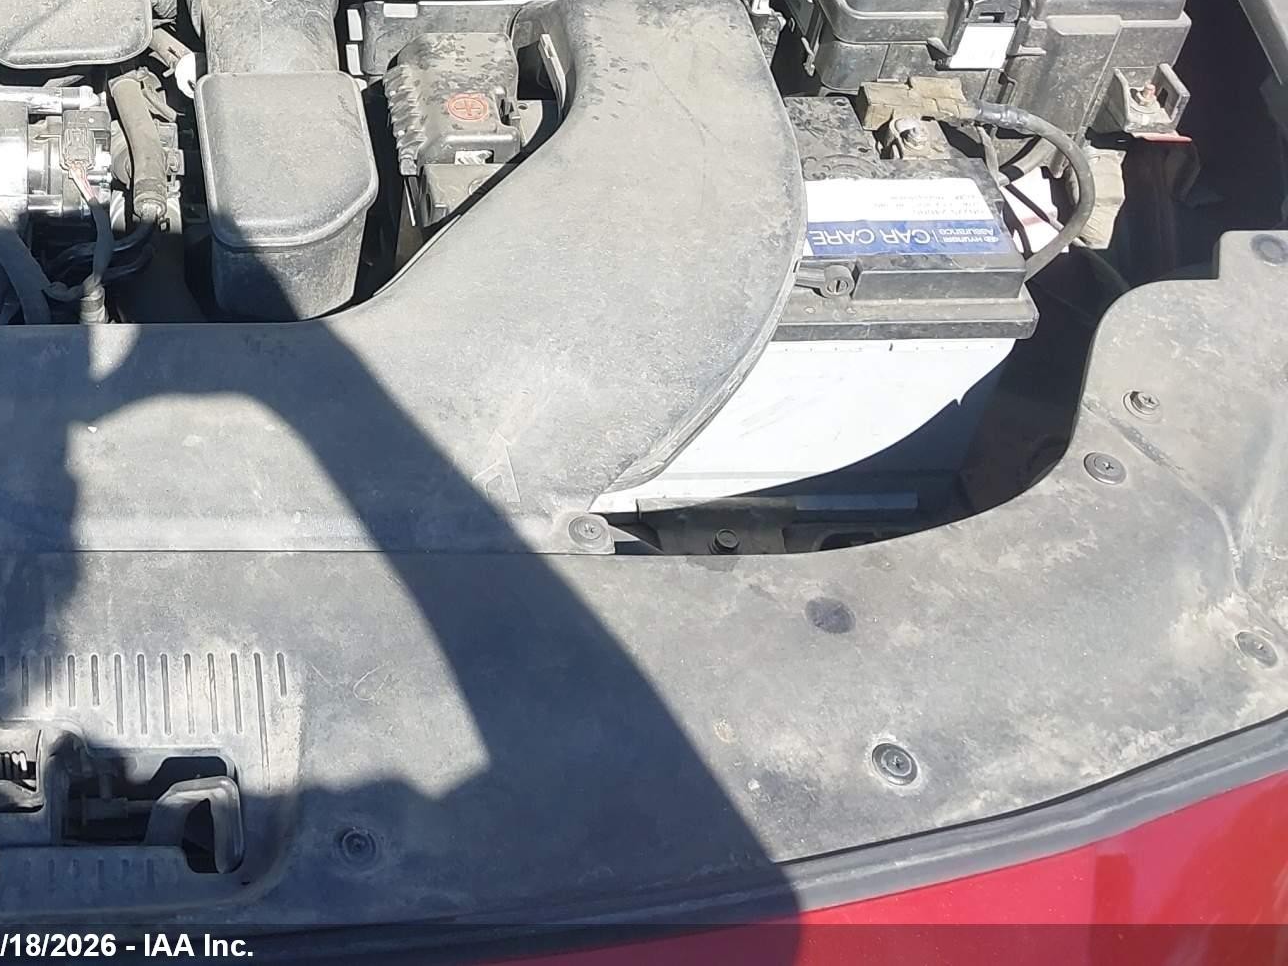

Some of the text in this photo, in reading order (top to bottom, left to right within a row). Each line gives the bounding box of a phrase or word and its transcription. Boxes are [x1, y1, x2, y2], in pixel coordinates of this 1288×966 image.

[808, 228, 931, 246] CAR CARE
[938, 228, 994, 236] Assurance
